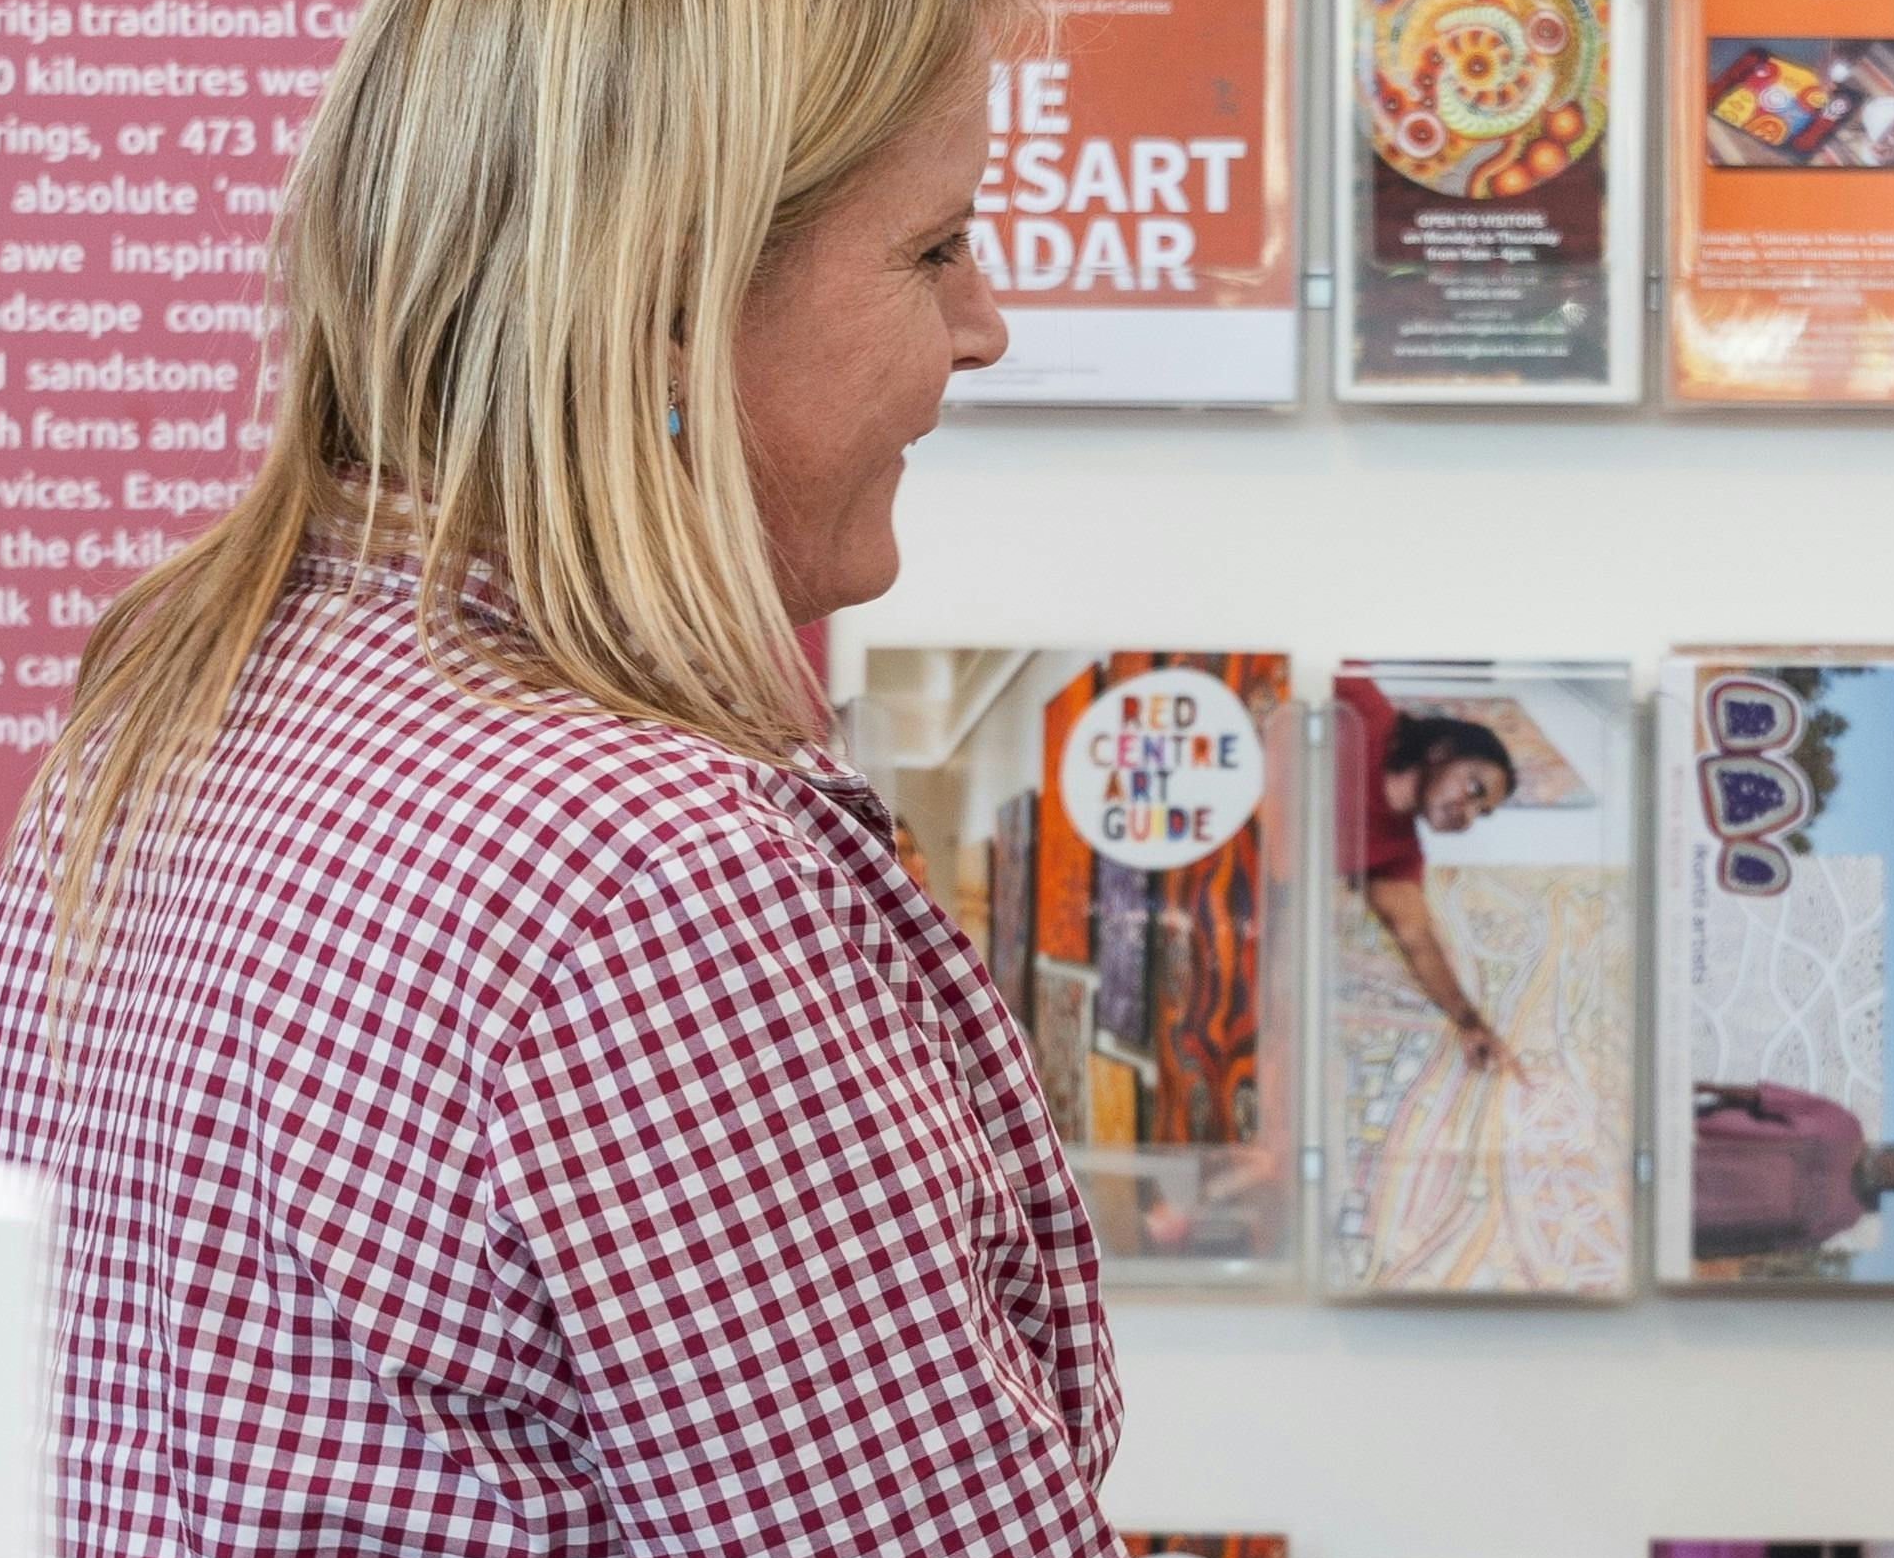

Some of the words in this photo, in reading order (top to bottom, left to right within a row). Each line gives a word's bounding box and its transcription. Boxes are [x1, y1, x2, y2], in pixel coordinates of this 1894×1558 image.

[26, 56, 248, 97] kilometres
[117, 125, 164, 155] or
[179, 118, 257, 156] 473
[12, 174, 198, 215] absolute
[972, 137, 1249, 215] ESART
[969, 220, 1198, 293] ADAR
[27, 352, 239, 392] sandstone
[31, 409, 140, 451] ferns
[149, 412, 227, 451] and
[1119, 694, 1198, 729] RED
[1087, 733, 1241, 769] CENTRE
[1102, 771, 1175, 803] ART
[1102, 804, 1214, 842] GUIDE
